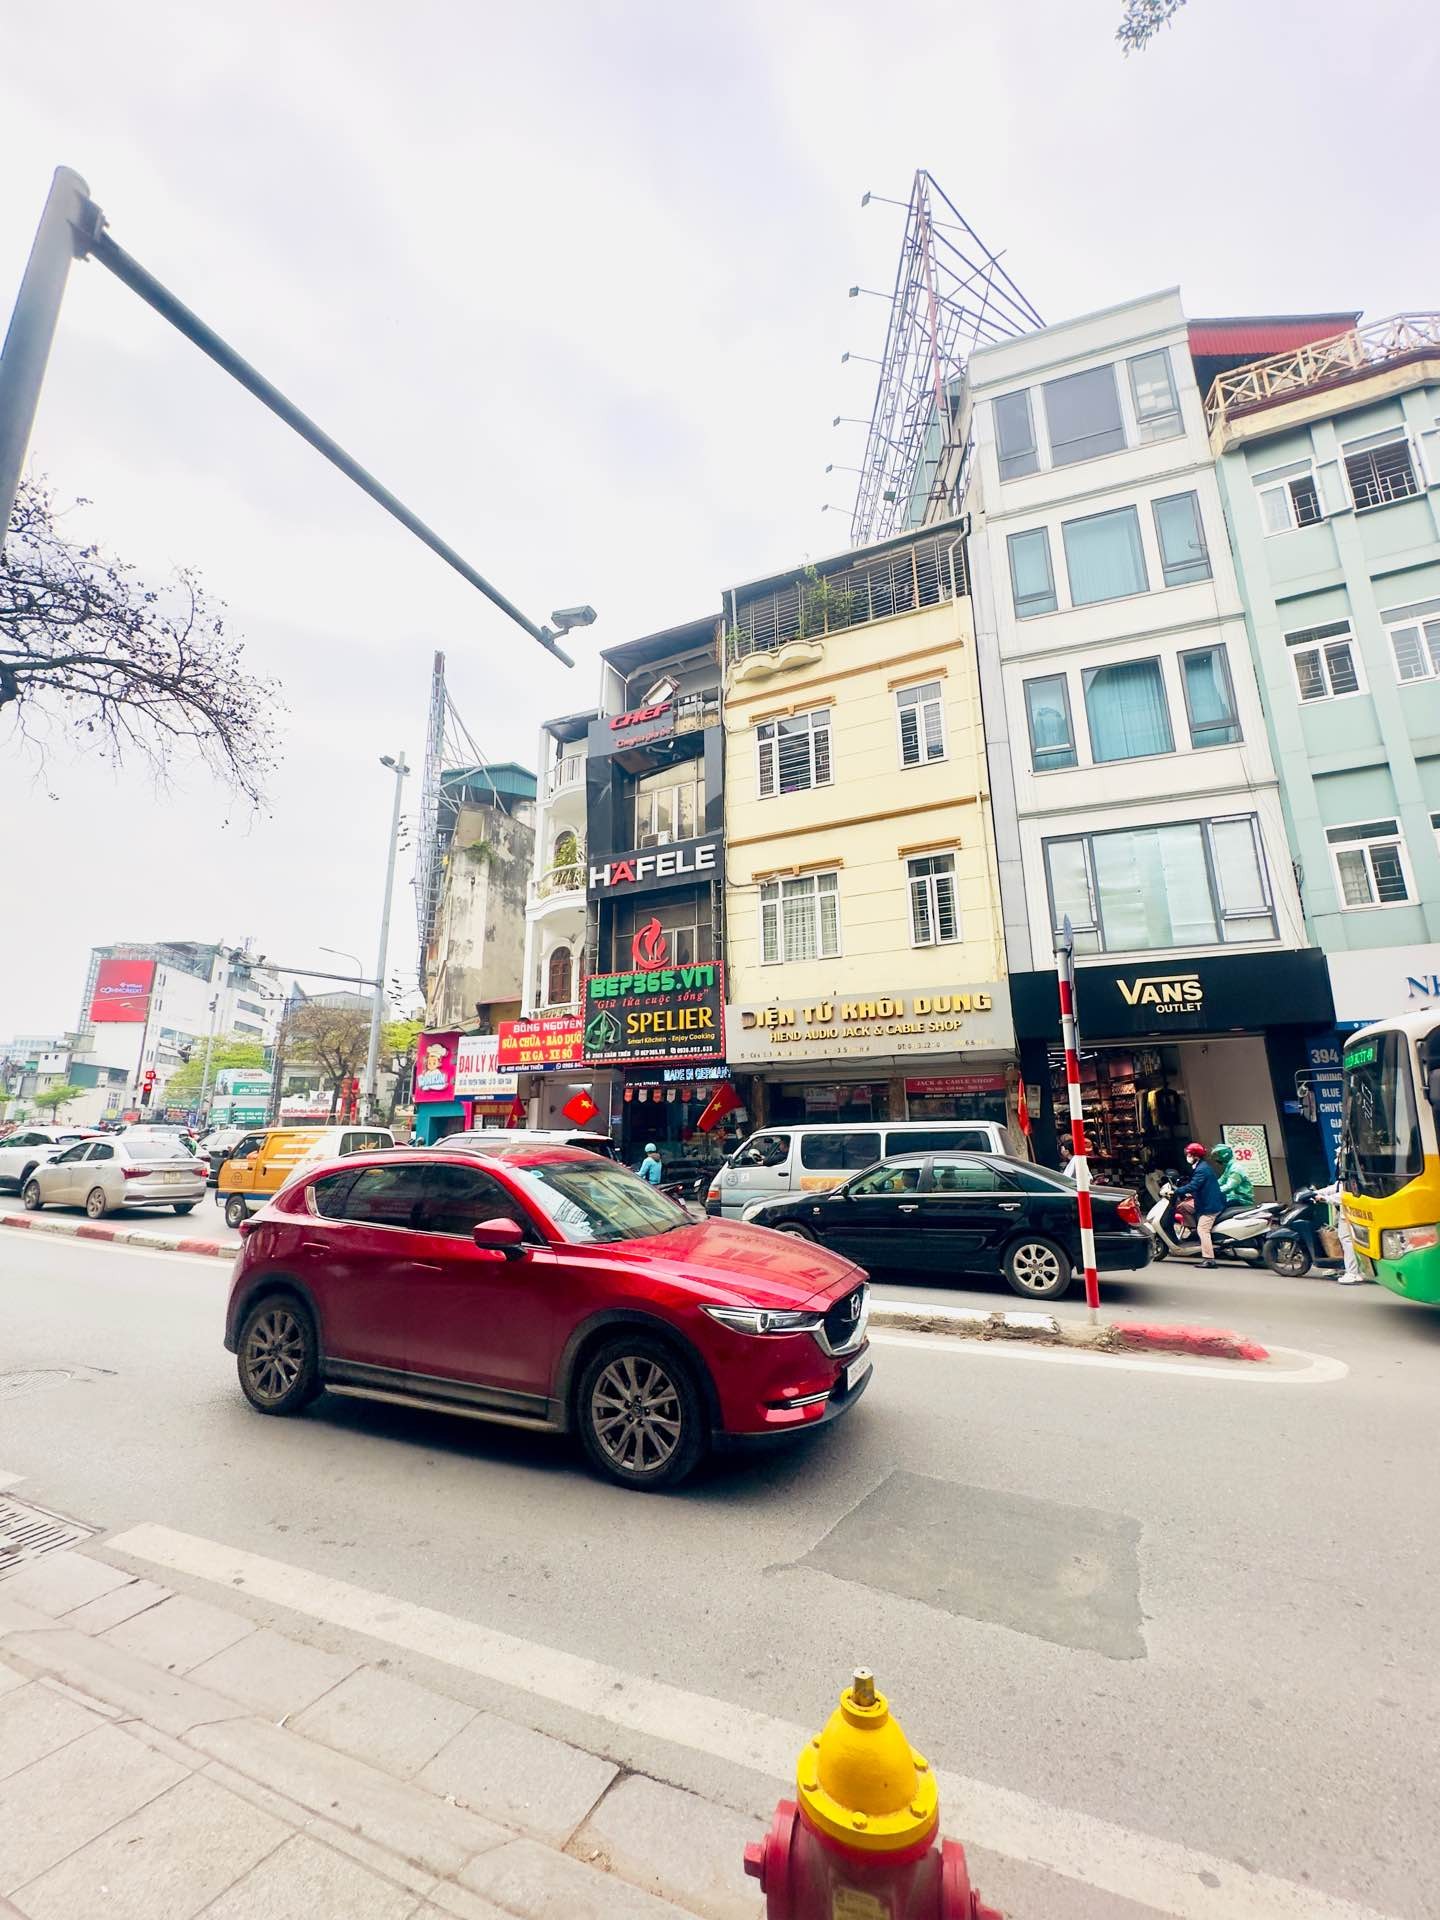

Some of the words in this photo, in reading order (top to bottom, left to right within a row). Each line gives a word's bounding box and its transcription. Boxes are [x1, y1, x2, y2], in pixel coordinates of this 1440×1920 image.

[608, 702, 672, 730] CHEF
[589, 844, 716, 889] HÄFELE
[1116, 974, 1203, 1005] VANS
[1156, 1002, 1203, 1014] OUTLET
[627, 1007, 715, 1034] SPELIER
[672, 1034, 689, 1042] Enjoy
[689, 1032, 716, 1041] Cooking
[769, 1030, 802, 1043] HIEND
[804, 1027, 839, 1040] AUDIO
[842, 1026, 871, 1038] JACK
[873, 1025, 883, 1036] &
[886, 1022, 926, 1035] CABLE
[928, 1019, 962, 1032] SHOP
[521, 1051, 531, 1061] XE
[532, 1050, 544, 1061] GA
[550, 1049, 560, 1060] XE
[1311, 1048, 1340, 1065] 394
[1321, 1088, 1341, 1098] BLUE
[1235, 1149, 1252, 1161] 38
